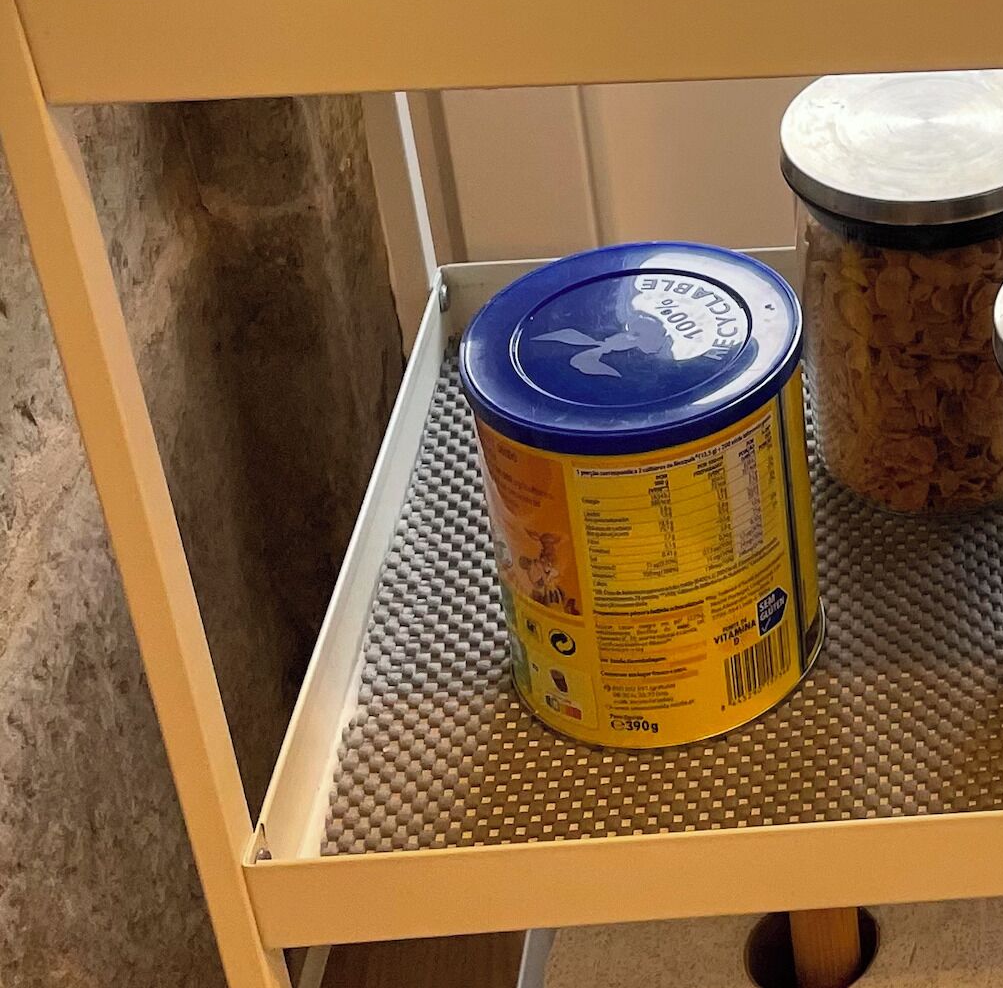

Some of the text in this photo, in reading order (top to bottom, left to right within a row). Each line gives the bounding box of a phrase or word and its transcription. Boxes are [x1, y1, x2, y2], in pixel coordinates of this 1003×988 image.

[640, 277, 739, 361] RECYCLABLE
[654, 298, 704, 341] 100%
[759, 593, 776, 612] SEM
[713, 619, 757, 644] VITAMINA
